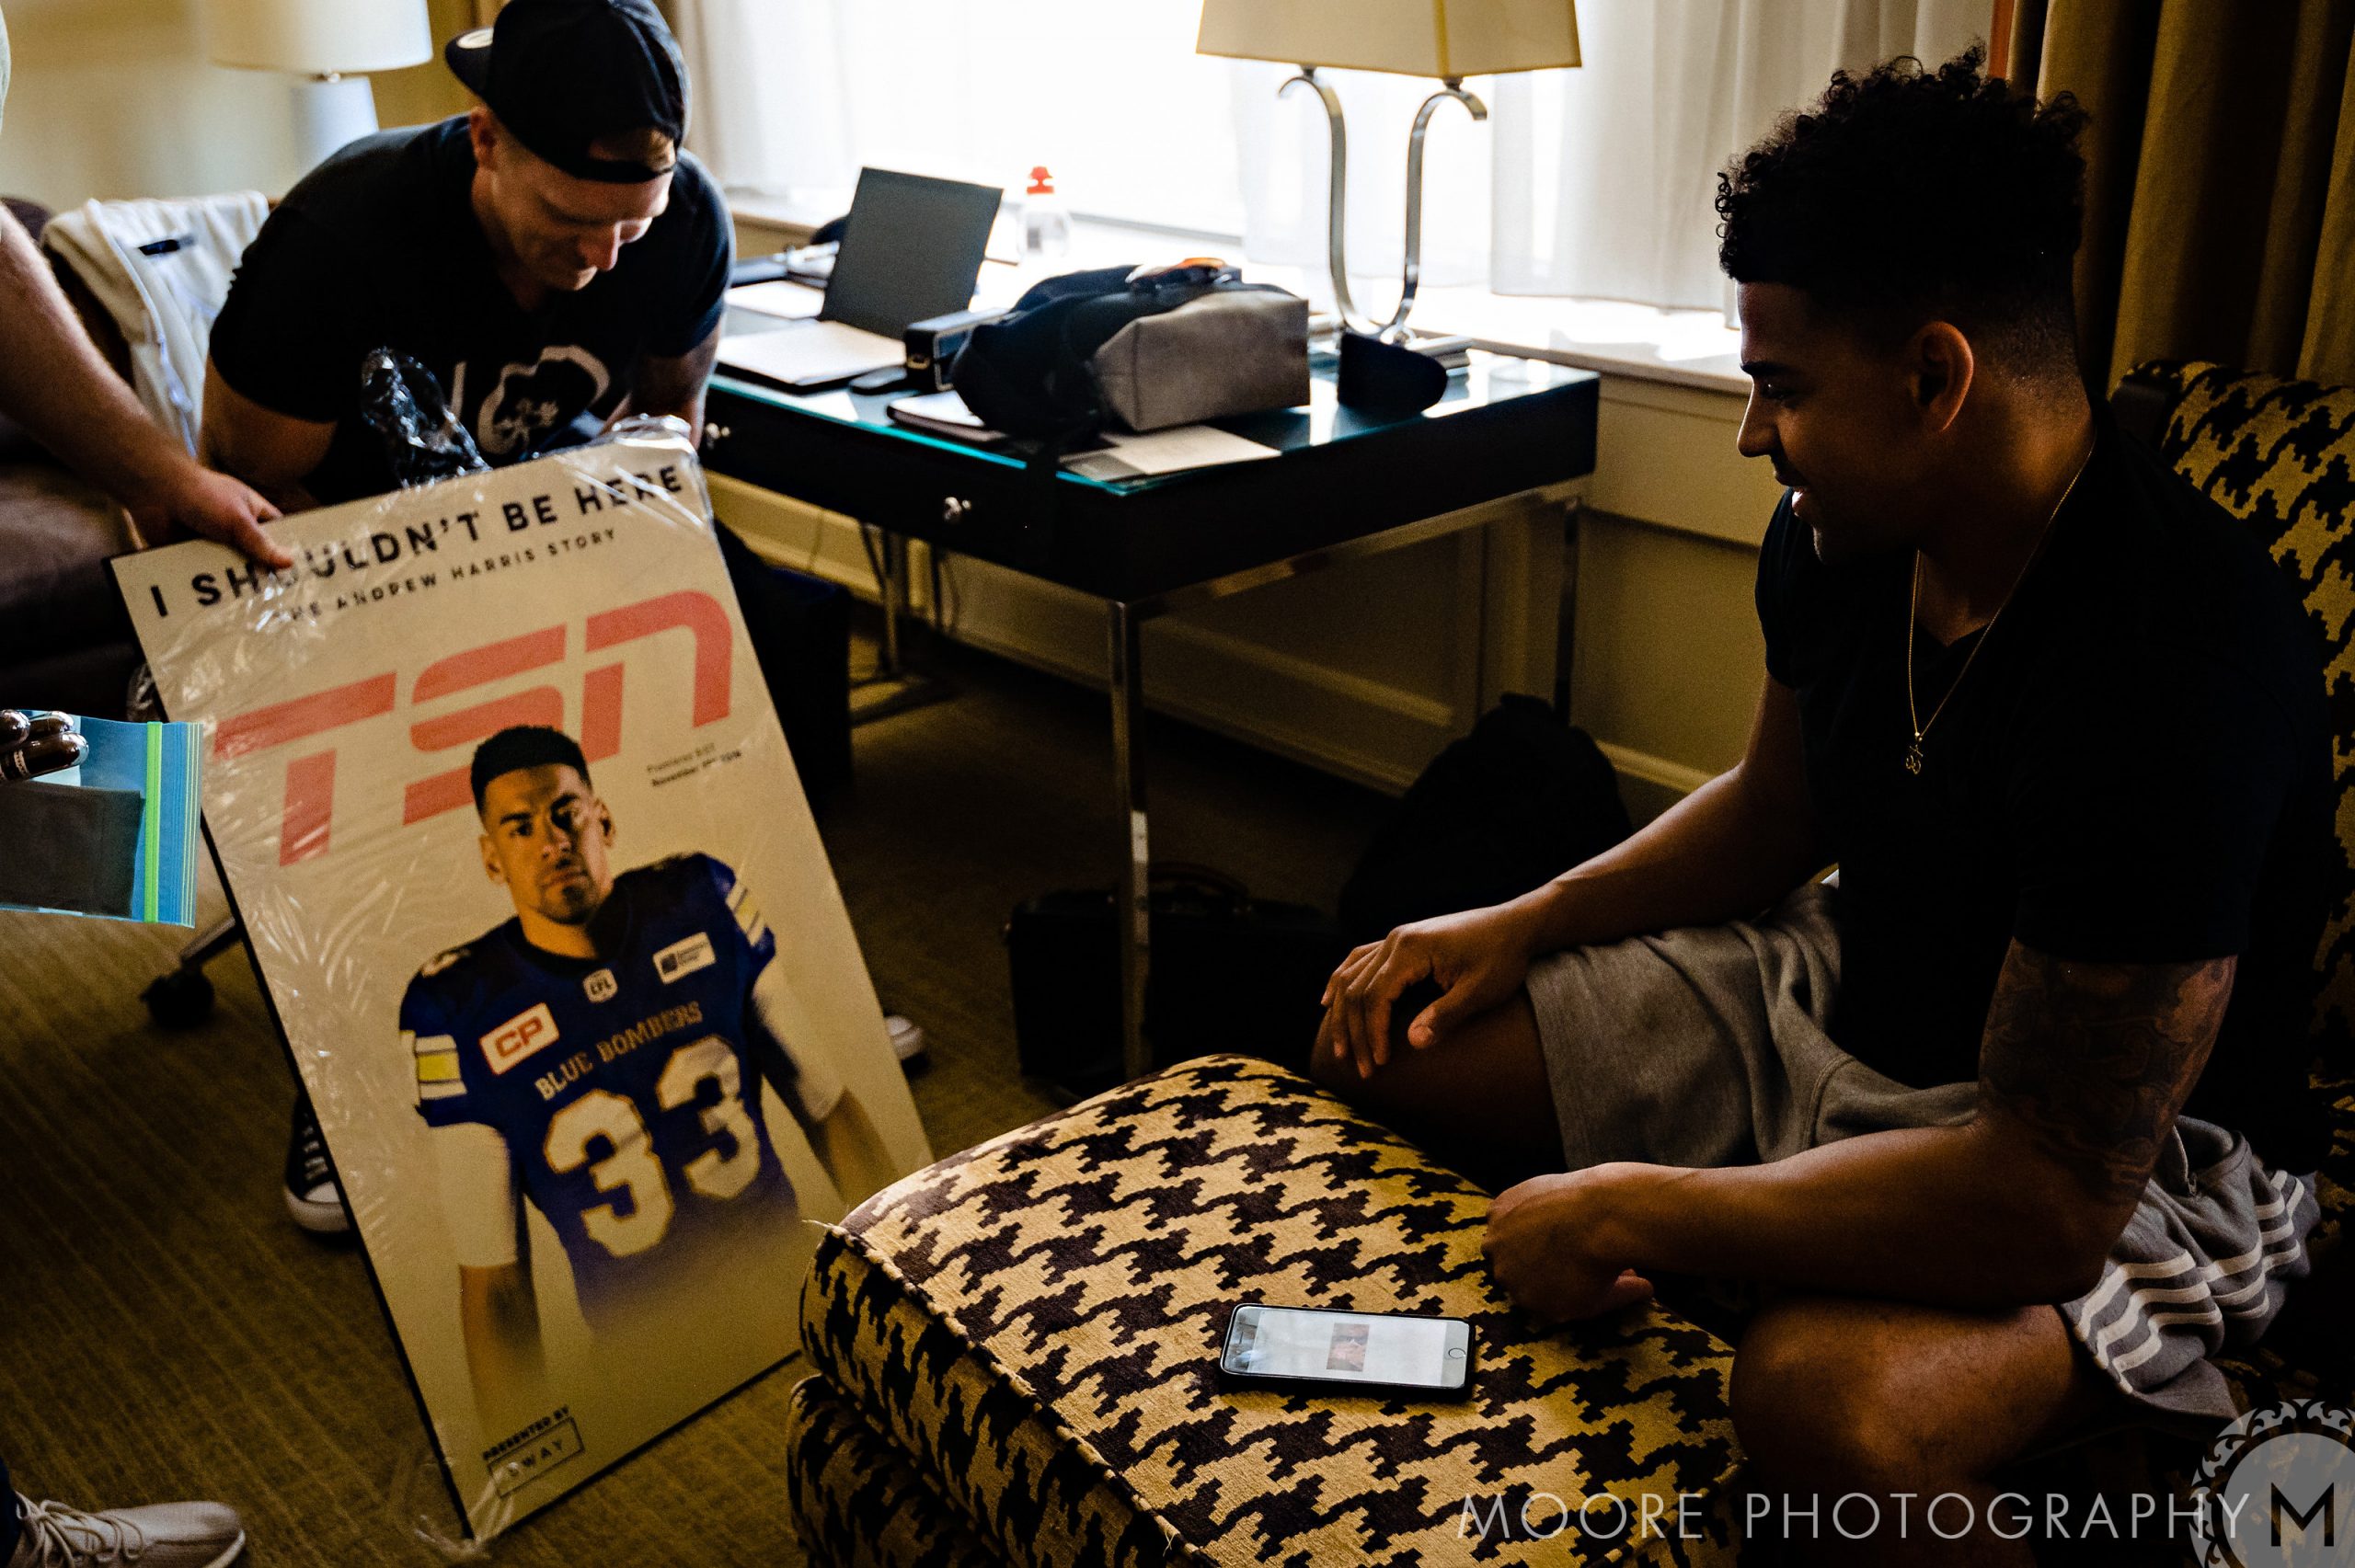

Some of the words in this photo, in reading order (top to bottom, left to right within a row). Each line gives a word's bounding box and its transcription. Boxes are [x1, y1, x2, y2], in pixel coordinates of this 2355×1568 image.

[151, 585, 168, 617] I
[502, 494, 557, 532] BE
[574, 465, 682, 515] HERE
[452, 548, 535, 580] HARRIS
[547, 528, 615, 556] STORY
[495, 1015, 544, 1059] CP
[534, 1050, 594, 1102] BLUE
[596, 1000, 704, 1064] BOMBERS
[543, 1033, 763, 1259] 33
